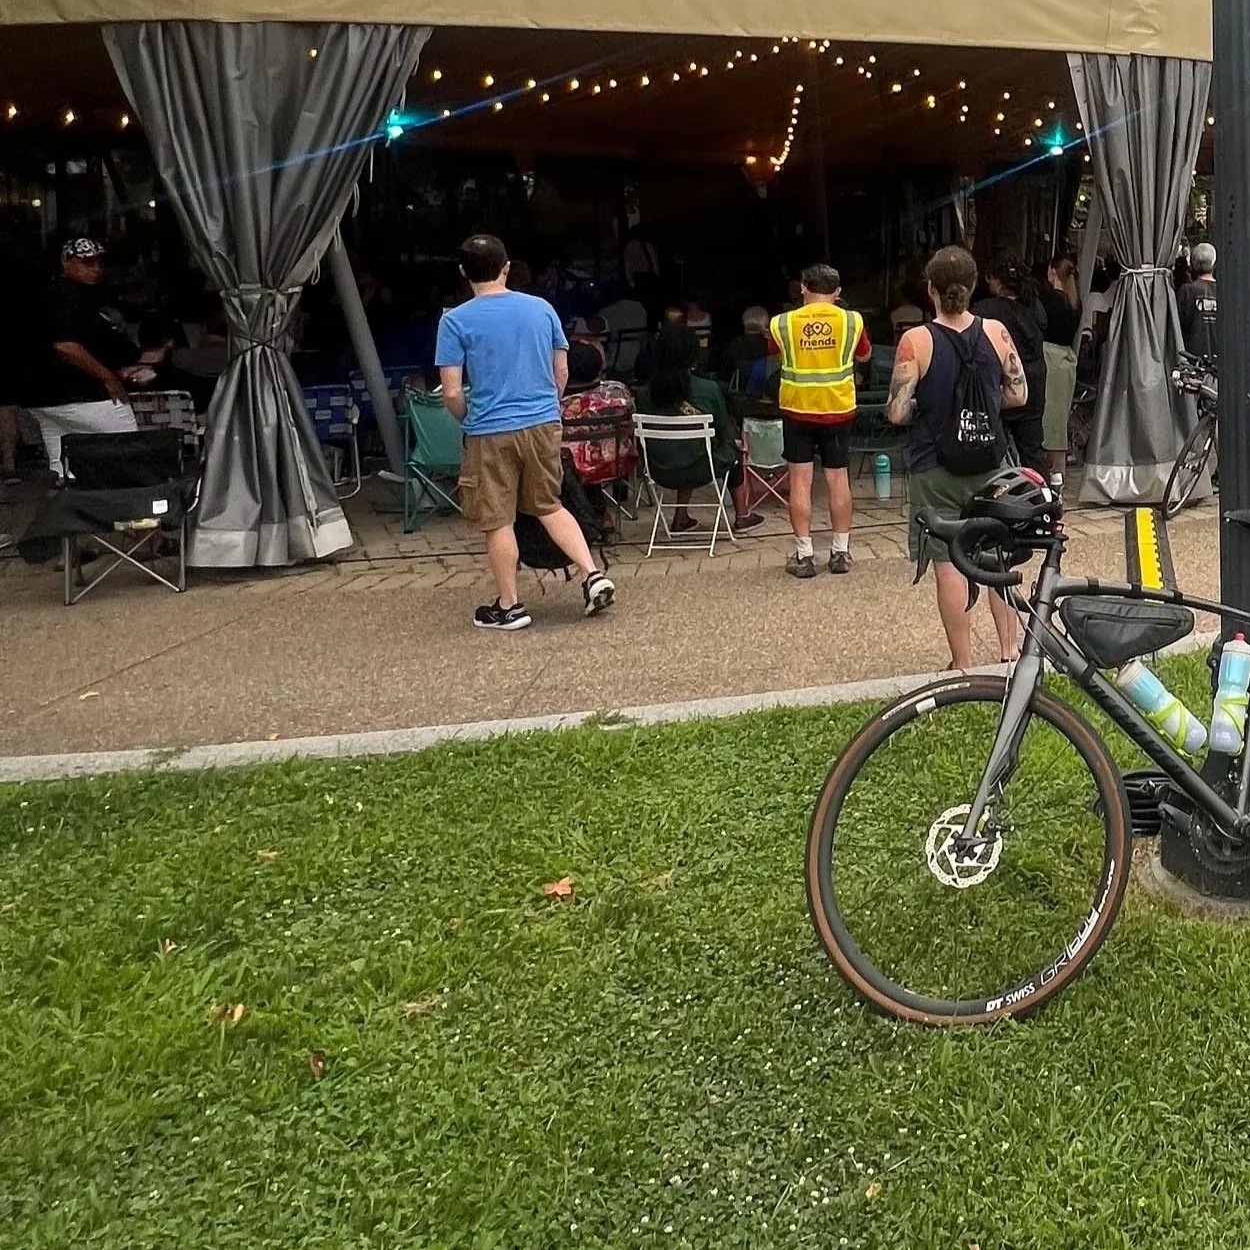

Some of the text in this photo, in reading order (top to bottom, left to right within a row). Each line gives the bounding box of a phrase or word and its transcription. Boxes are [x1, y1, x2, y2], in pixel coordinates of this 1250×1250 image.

[800, 338, 836, 347] friends
[986, 998, 1004, 1012] DT
[1005, 982, 1036, 1006] SWISS
